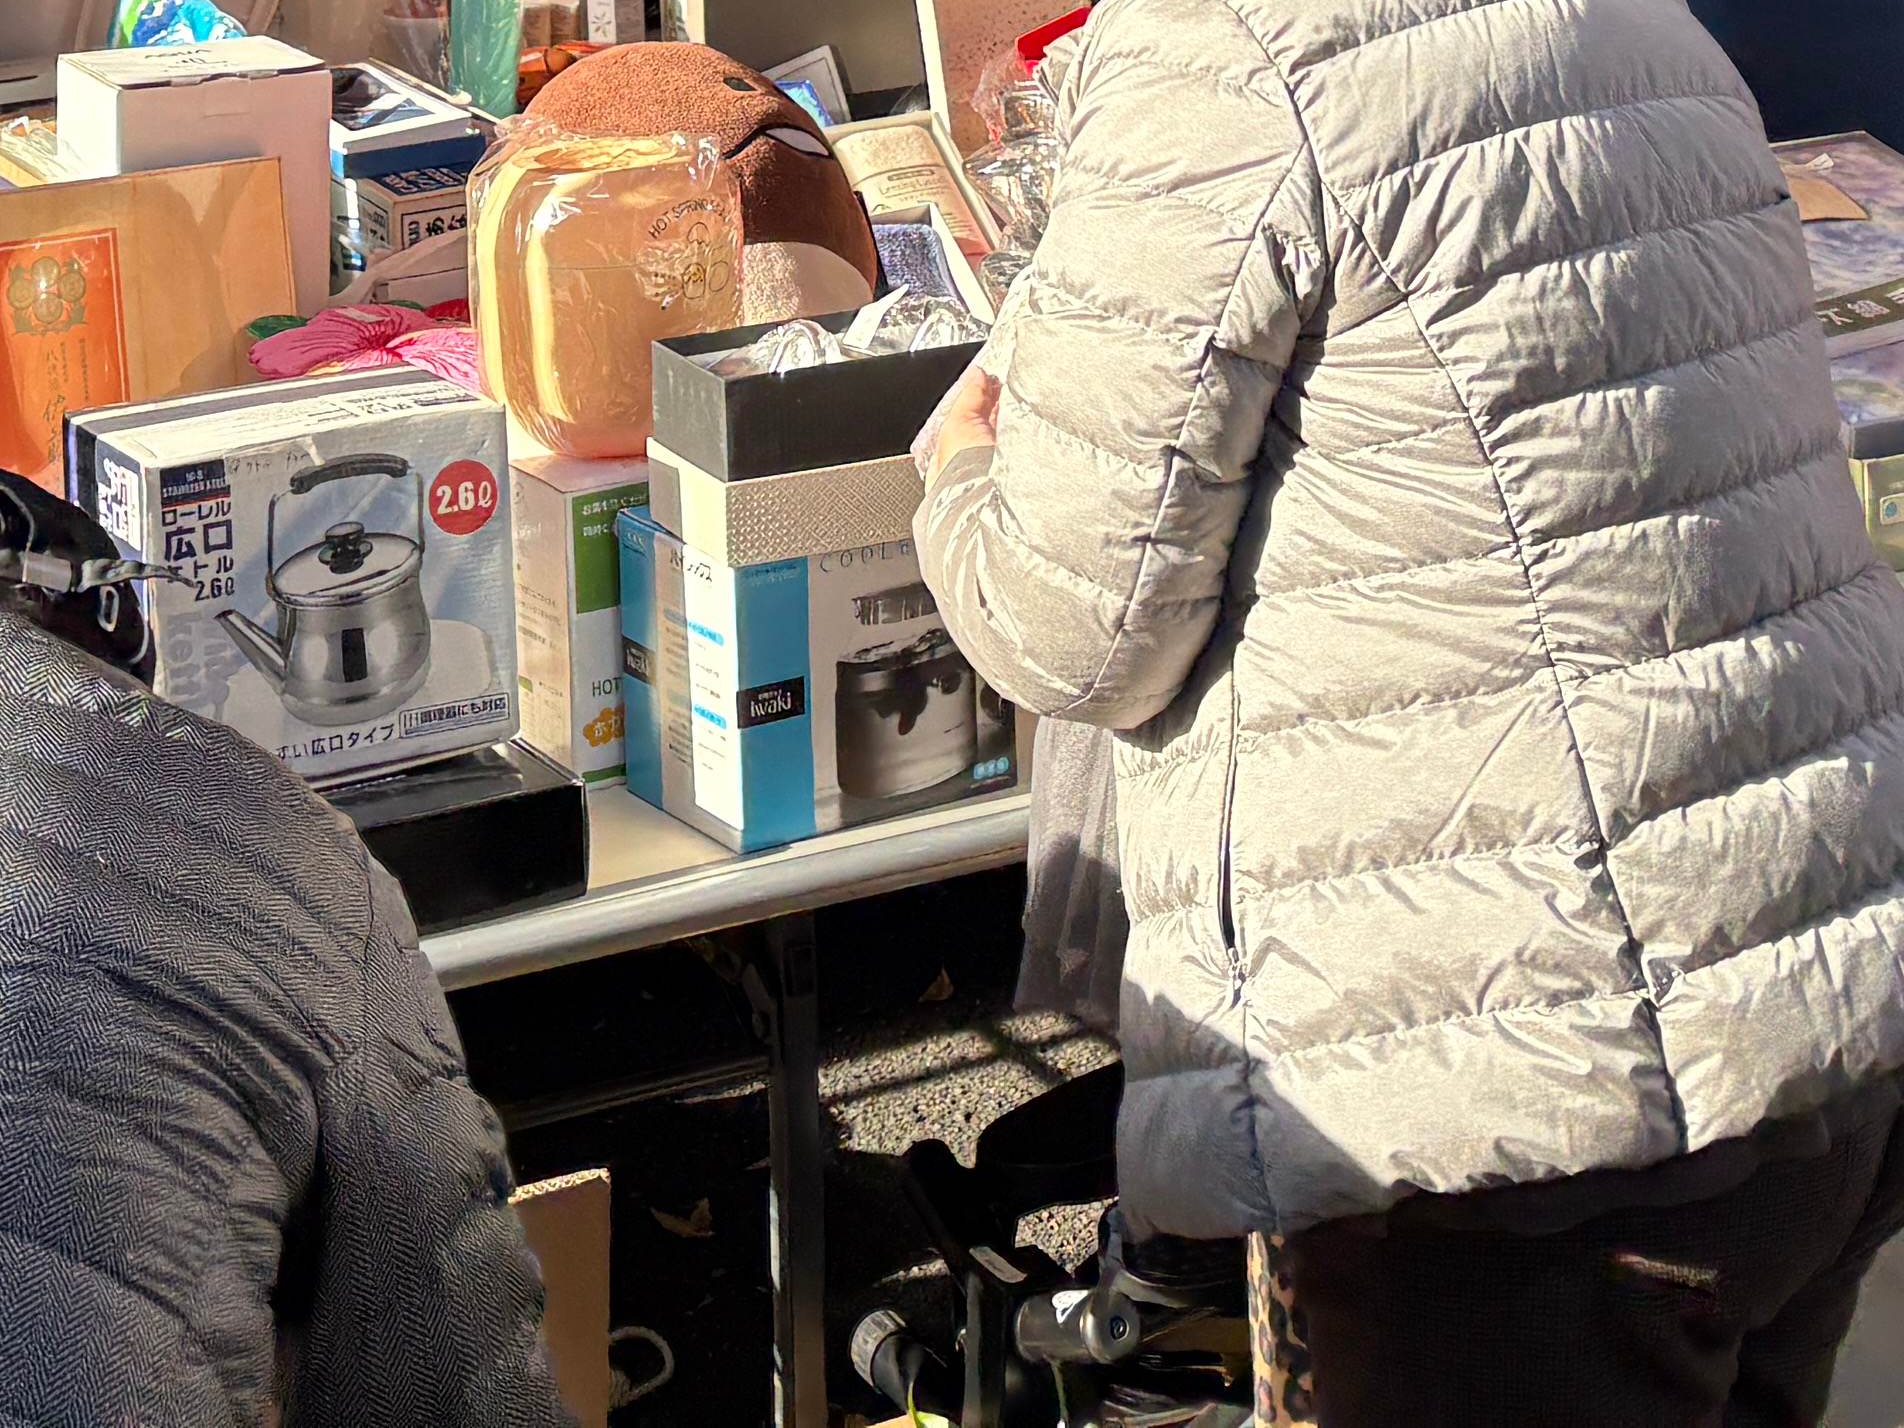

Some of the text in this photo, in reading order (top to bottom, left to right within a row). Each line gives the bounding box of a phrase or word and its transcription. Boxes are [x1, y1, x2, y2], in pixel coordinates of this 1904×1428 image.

[649, 211, 672, 239] HOT
[162, 501, 232, 527] ローレル
[165, 519, 233, 563] 広口
